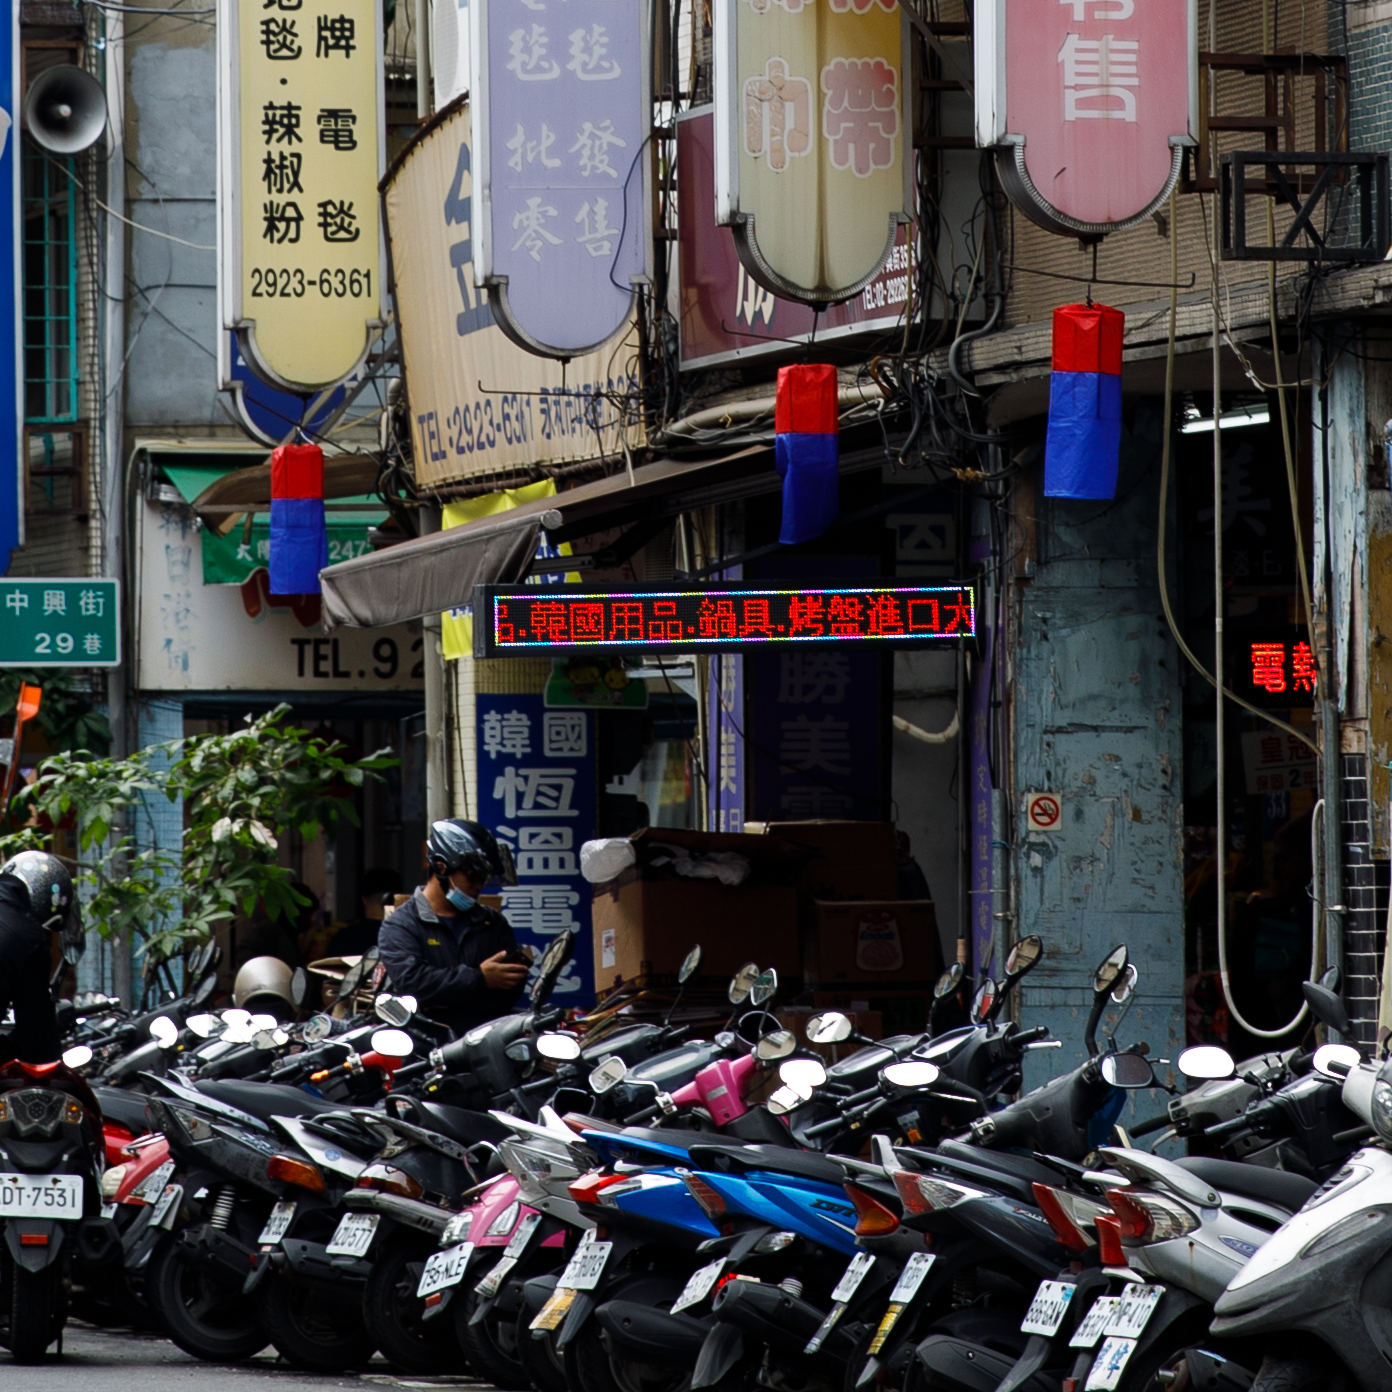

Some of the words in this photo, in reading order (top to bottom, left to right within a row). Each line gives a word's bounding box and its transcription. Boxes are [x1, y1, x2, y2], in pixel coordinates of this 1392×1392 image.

[250, 268, 373, 300] 2923-6361
[5, 589, 104, 618] 中興街
[483, 710, 587, 759] 韓國
